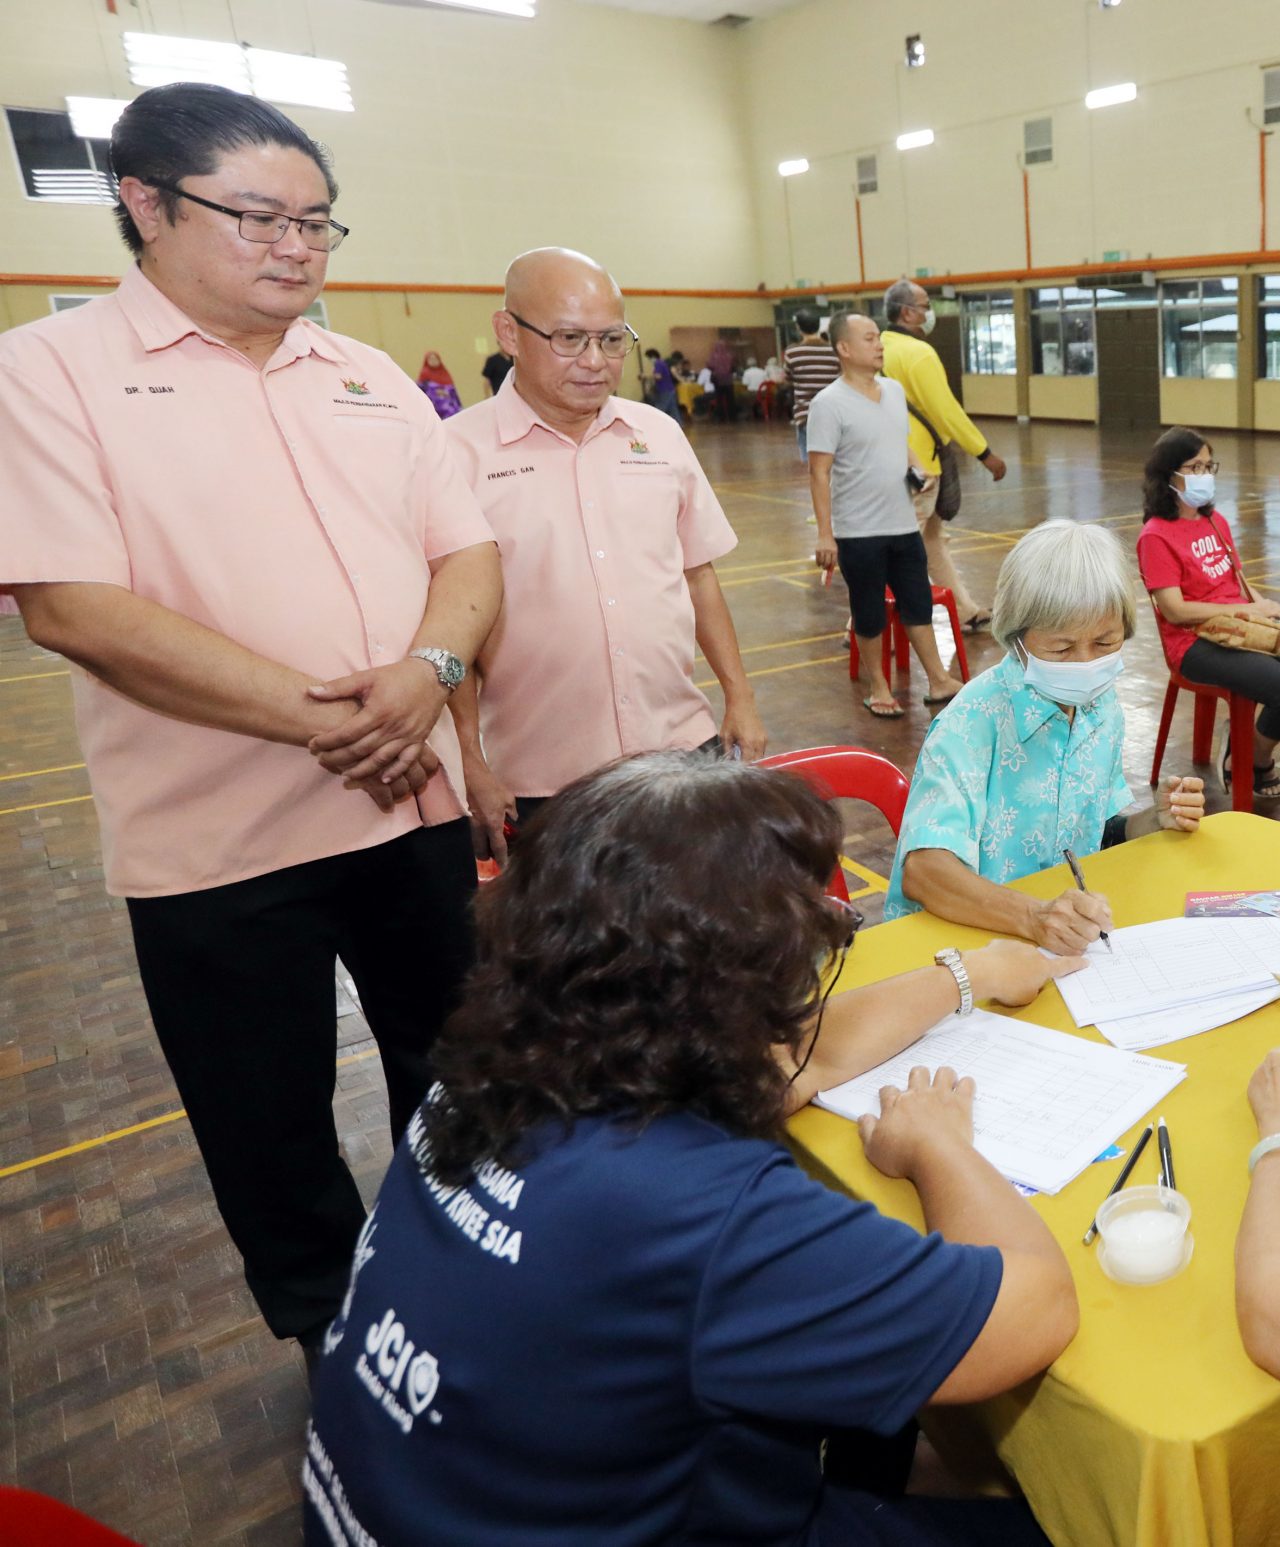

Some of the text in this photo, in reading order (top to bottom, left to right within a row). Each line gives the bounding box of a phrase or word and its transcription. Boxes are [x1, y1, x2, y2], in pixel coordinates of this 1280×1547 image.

[124, 386, 175, 394] DR. QUAH
[487, 469, 517, 480] FRANCIS
[1191, 534, 1222, 558] COOL
[444, 1187, 490, 1242] KWEE
[480, 1219, 523, 1265] SIA
[365, 1308, 415, 1391] JCI
